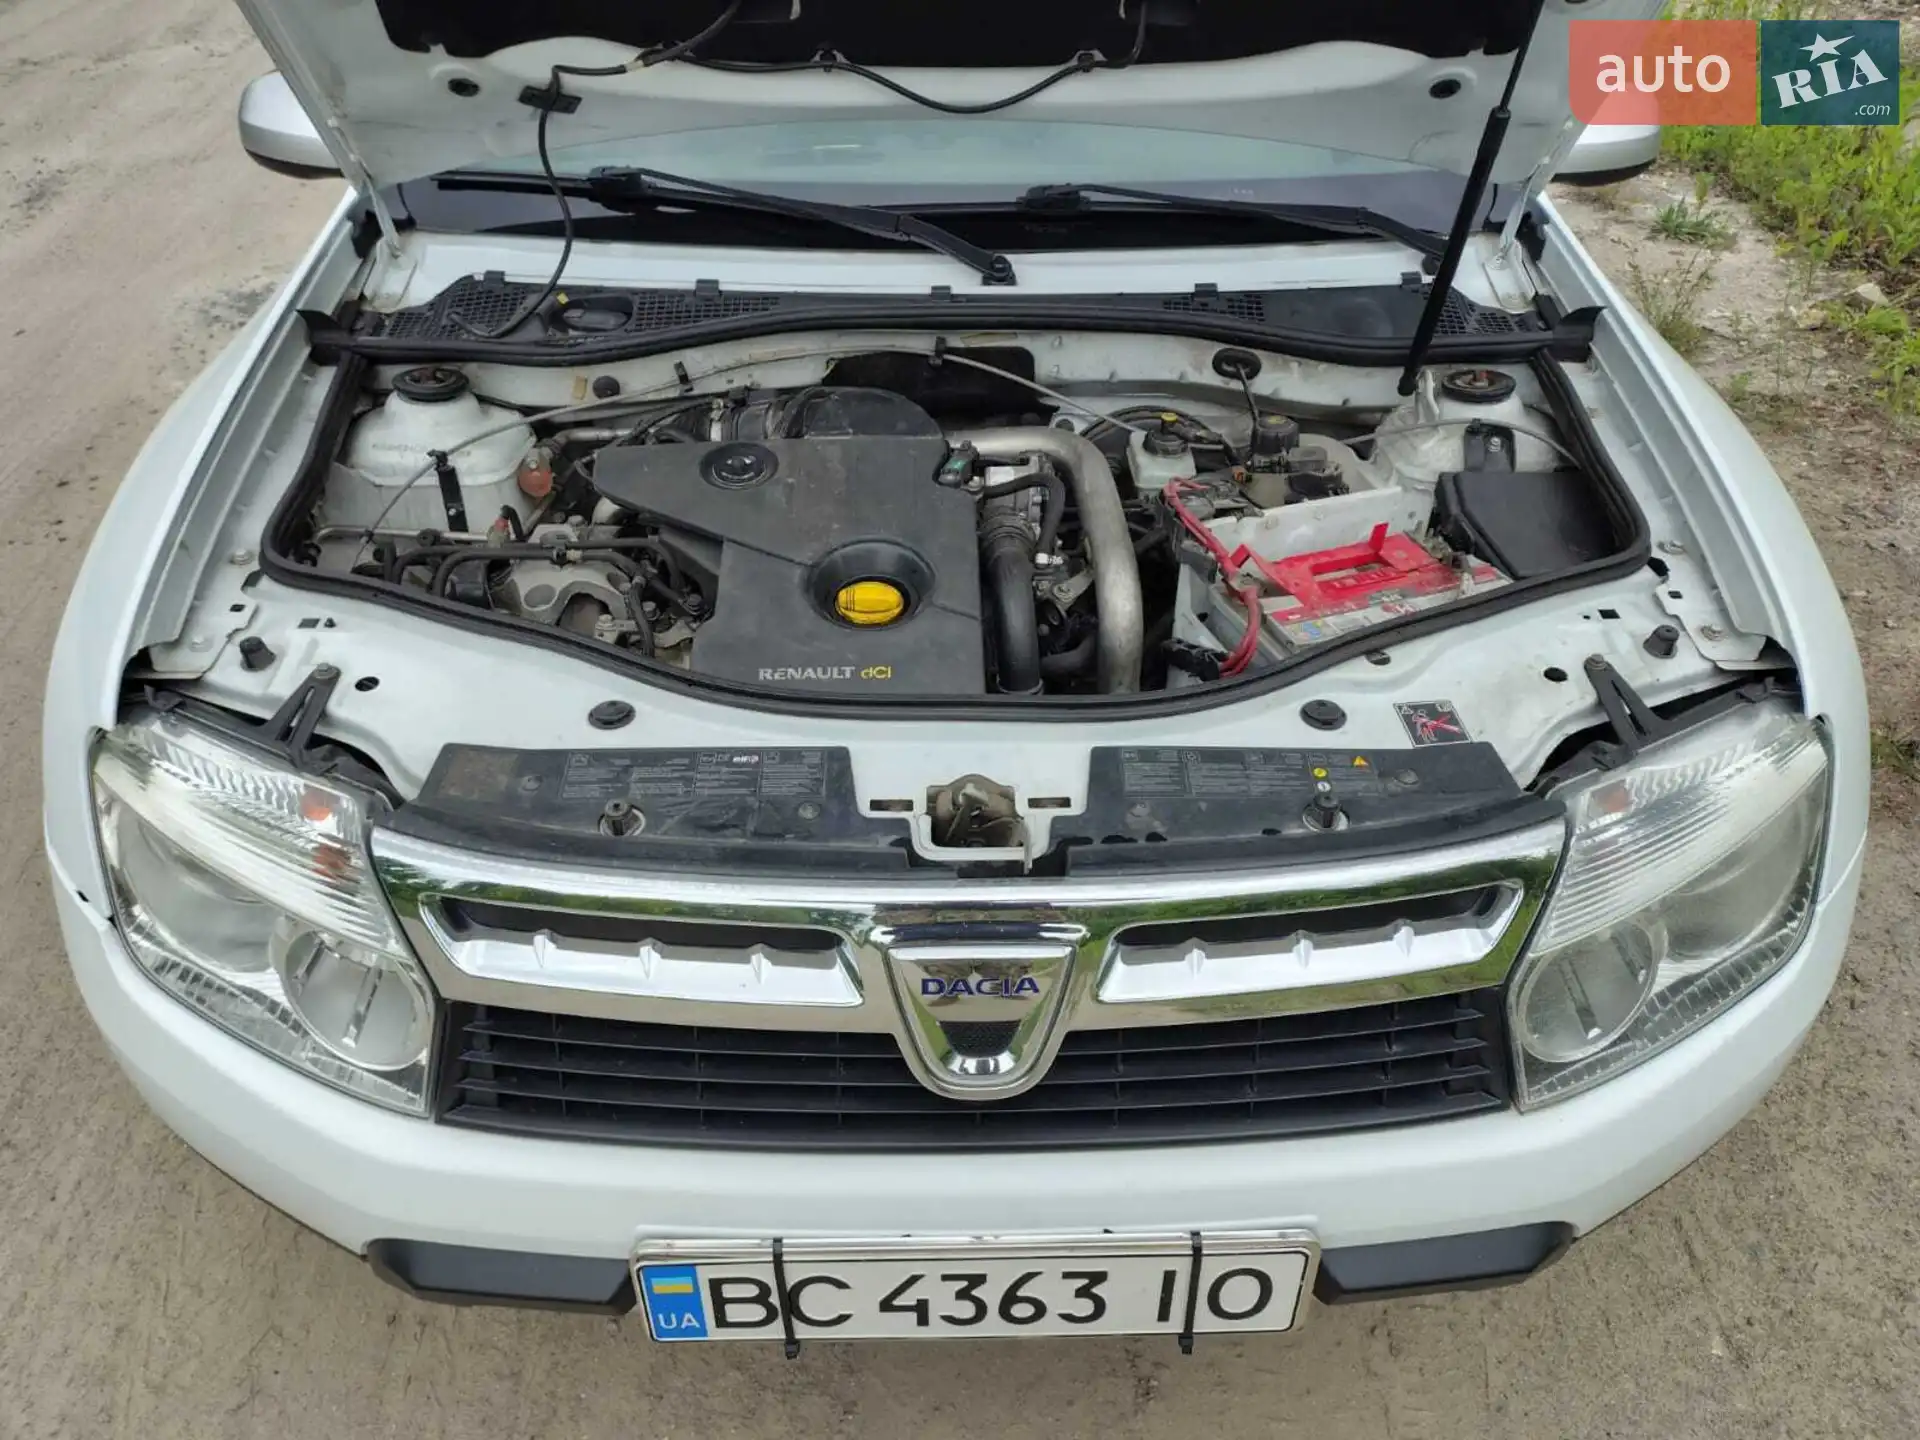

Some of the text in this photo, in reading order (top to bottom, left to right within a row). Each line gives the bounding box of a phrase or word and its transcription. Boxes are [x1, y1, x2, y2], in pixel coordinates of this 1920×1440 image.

[758, 666, 856, 681] RENAULT
[920, 976, 1041, 997] DACIA
[708, 1274, 852, 1329] BC
[878, 1270, 1109, 1327] 4363
[658, 1311, 701, 1330] UA
